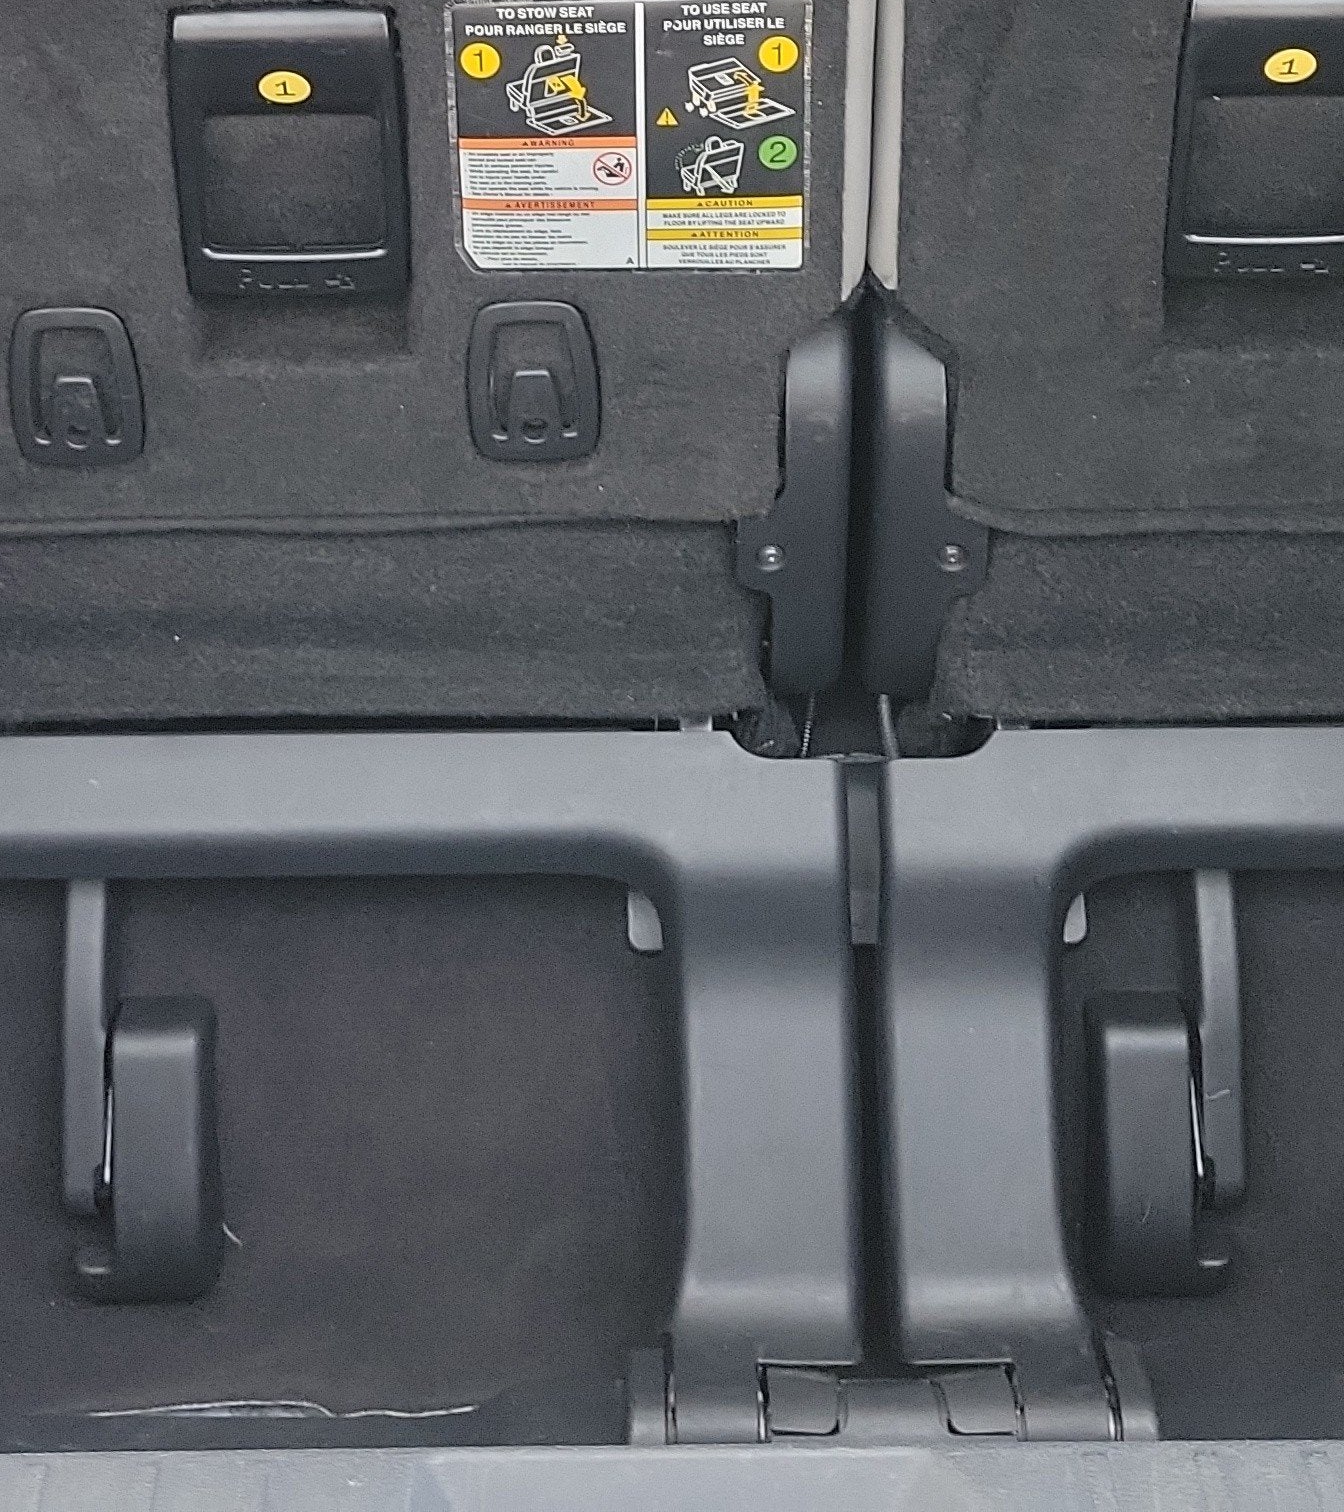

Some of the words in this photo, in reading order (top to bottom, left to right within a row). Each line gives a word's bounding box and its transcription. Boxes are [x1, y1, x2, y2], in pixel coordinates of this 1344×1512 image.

[496, 8, 515, 20] TO
[517, 7, 557, 19] STOW
[558, 6, 595, 18] SEAT
[681, 4, 700, 16] TO
[702, 3, 731, 15] USE
[732, 2, 768, 14] SEAT
[465, 24, 504, 36] POUR
[506, 23, 564, 36] RANGER
[565, 23, 584, 34] LE
[584, 20, 627, 34] SIÈGE
[663, 20, 702, 31] POUR
[703, 18, 765, 31] UTILISER
[767, 17, 785, 29] LE
[703, 32, 745, 46] SIÈGE
[473, 49, 483, 72] 1
[771, 42, 782, 65] 1
[1278, 57, 1299, 76] 1
[274, 80, 296, 97] 1
[530, 139, 575, 147] WARNING
[769, 141, 787, 164] 2
[514, 201, 595, 209] AVERTISSEMENT
[704, 199, 754, 207] CAUTION
[699, 230, 759, 238] ATTENTION
[625, 256, 635, 265] A
